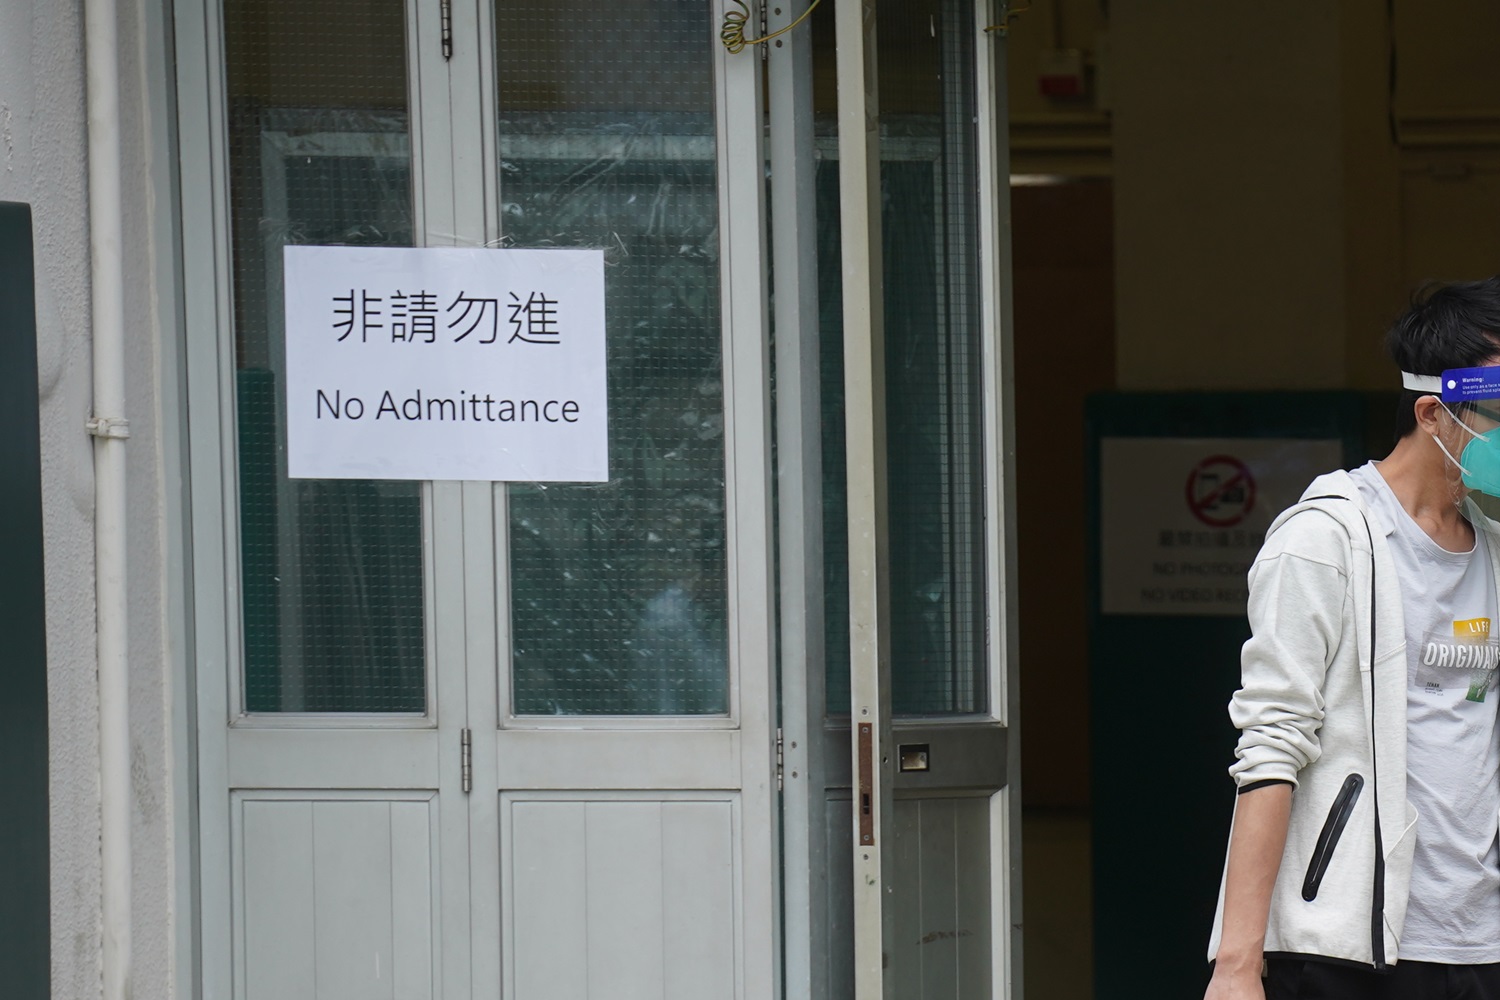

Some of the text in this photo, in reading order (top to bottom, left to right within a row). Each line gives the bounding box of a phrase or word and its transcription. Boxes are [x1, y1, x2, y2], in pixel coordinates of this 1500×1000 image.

[331, 288, 562, 345] 非請勿進
[316, 389, 580, 423] No Admittance
